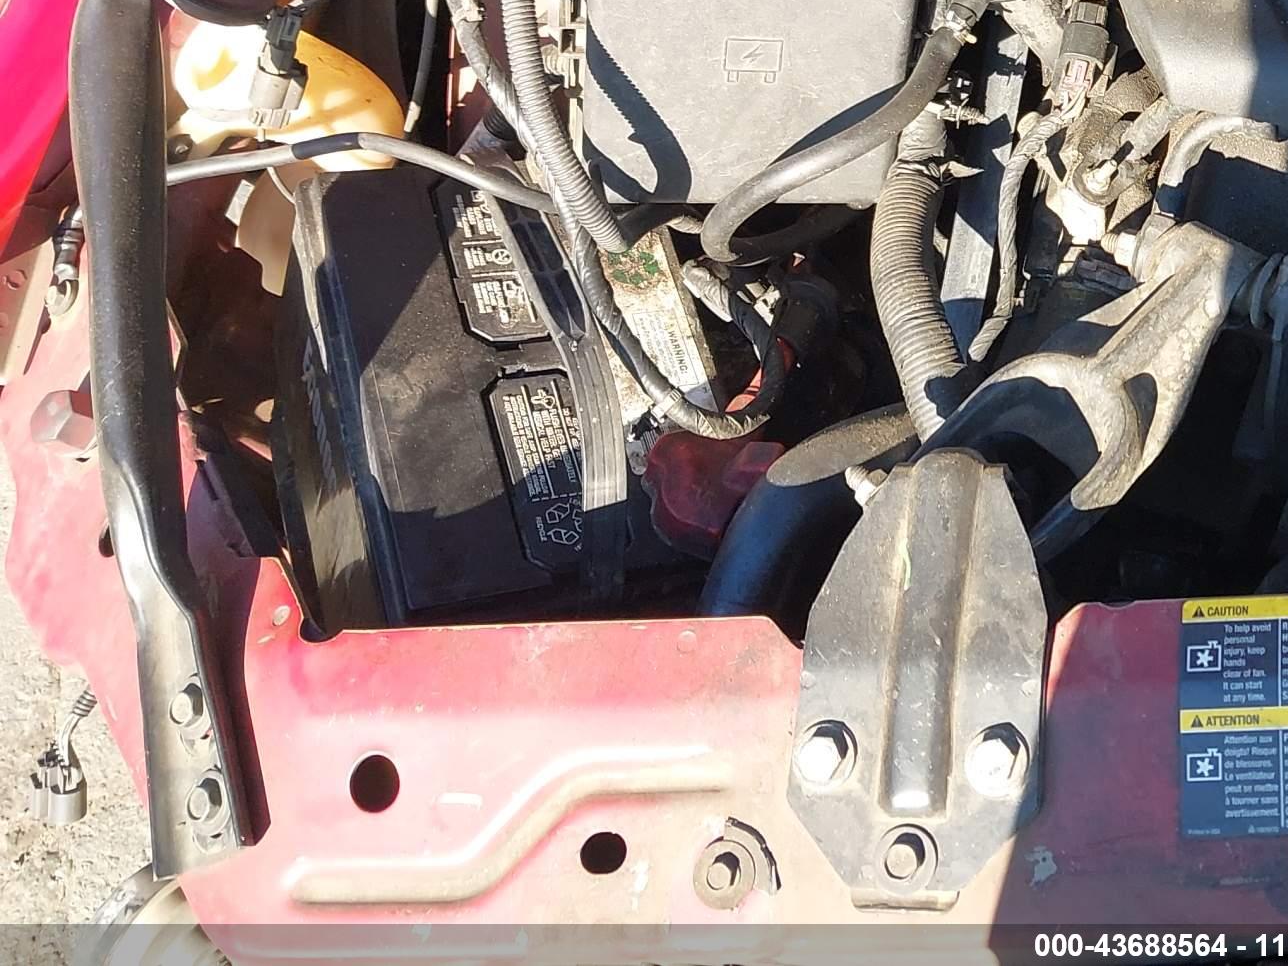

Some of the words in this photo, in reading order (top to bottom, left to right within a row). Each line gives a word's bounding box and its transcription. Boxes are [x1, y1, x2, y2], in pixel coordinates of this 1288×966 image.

[668, 330, 688, 375] WARNING:
[532, 410, 545, 436] MEDICAL
[549, 408, 560, 428] FLUSH
[555, 428, 565, 444] EYES
[541, 409, 551, 426] WITH
[552, 448, 560, 458] GET
[540, 437, 551, 453] HELP
[545, 453, 555, 468] FAST
[536, 516, 547, 542] RECYCLE
[1207, 606, 1248, 616] CAUTION
[1224, 624, 1232, 633] To
[1235, 624, 1250, 633] help
[1252, 623, 1271, 631] avoid
[1224, 635, 1255, 645] personal
[1247, 646, 1265, 655] keep
[1224, 658, 1245, 666] hands
[1223, 670, 1241, 678] clear
[1243, 669, 1251, 677] of
[1223, 682, 1228, 690] It
[1245, 681, 1262, 689] start
[1232, 695, 1246, 703] any
[1206, 714, 1260, 726] ATTENTION
